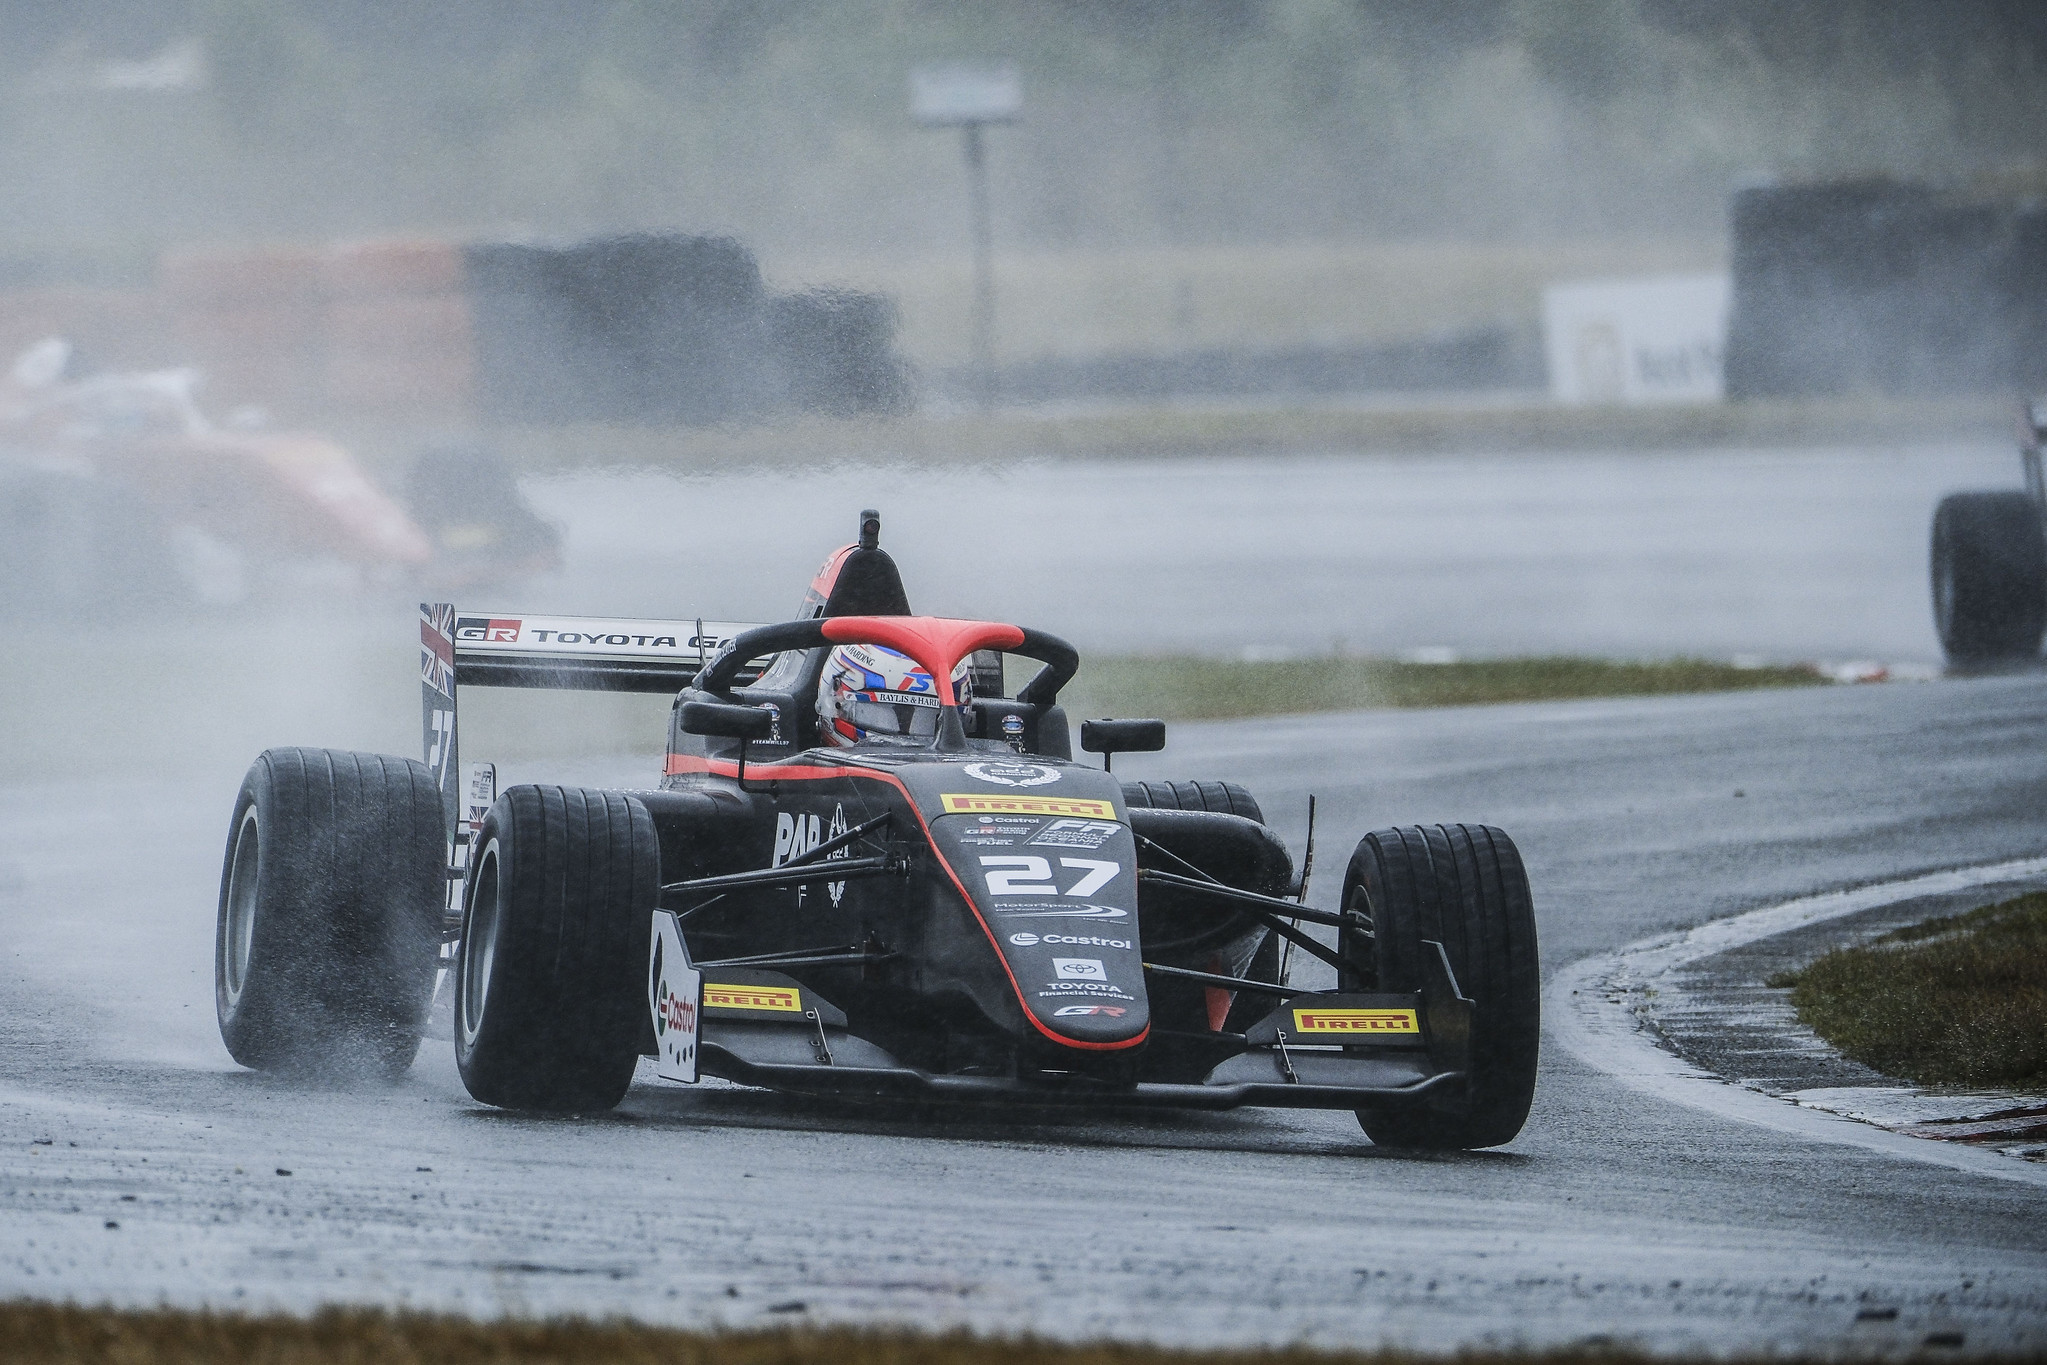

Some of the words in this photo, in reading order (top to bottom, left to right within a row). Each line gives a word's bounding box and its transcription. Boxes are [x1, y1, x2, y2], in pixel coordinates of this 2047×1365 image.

[456, 627, 518, 642] GR
[531, 630, 677, 648] TOYOTA
[848, 646, 876, 667] HARDING
[880, 693, 909, 703] BAYLIS
[951, 797, 1104, 815] PIRELLI
[1048, 819, 1121, 835] FR
[978, 855, 1121, 898] 27
[1042, 934, 1131, 949] Castrol
[1046, 982, 1123, 993] TOYOTA
[1090, 991, 1134, 1000] Services
[667, 991, 697, 1034] Castrol
[1053, 1005, 1126, 1017] GR
[1301, 1014, 1411, 1029] PIRELLI
